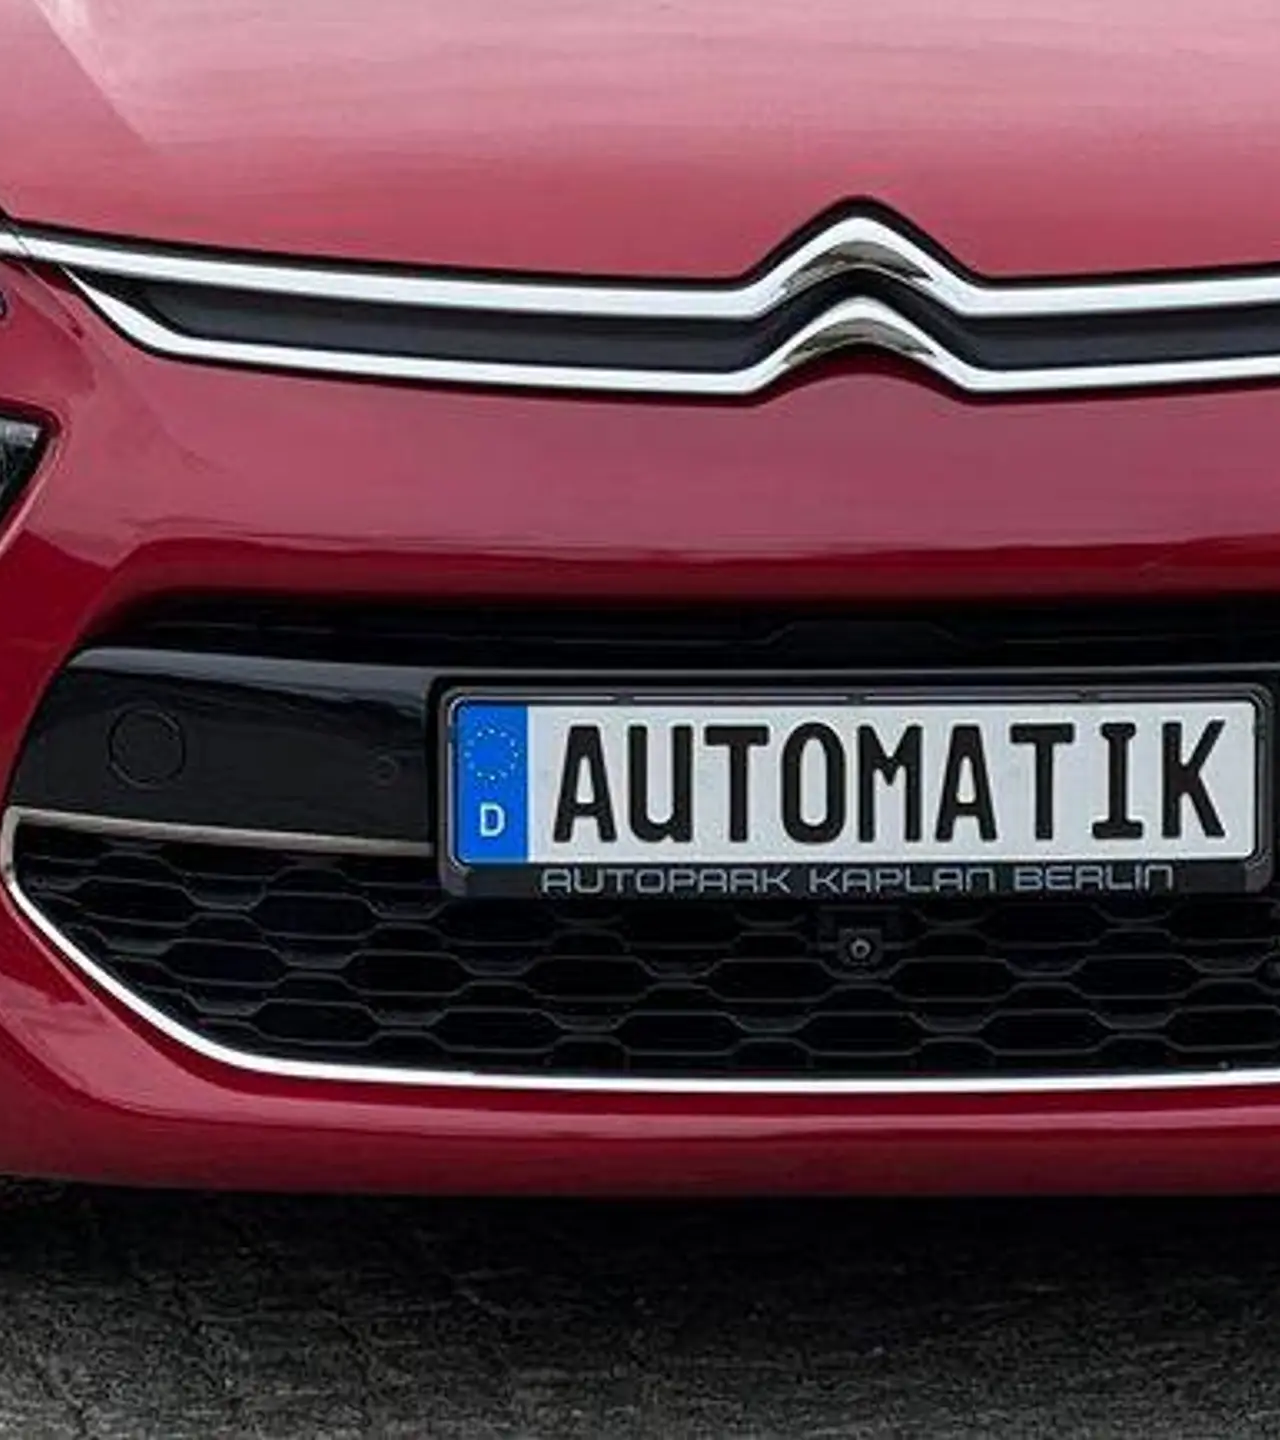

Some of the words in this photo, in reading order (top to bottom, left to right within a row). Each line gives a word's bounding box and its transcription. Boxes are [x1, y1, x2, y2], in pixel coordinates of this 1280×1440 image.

[480, 802, 505, 837] D
[552, 720, 1226, 844] AUTOMATIK
[541, 867, 790, 894] AUTOPARK
[809, 865, 996, 893] KAPLAN
[1013, 863, 1173, 891] BERLIN
